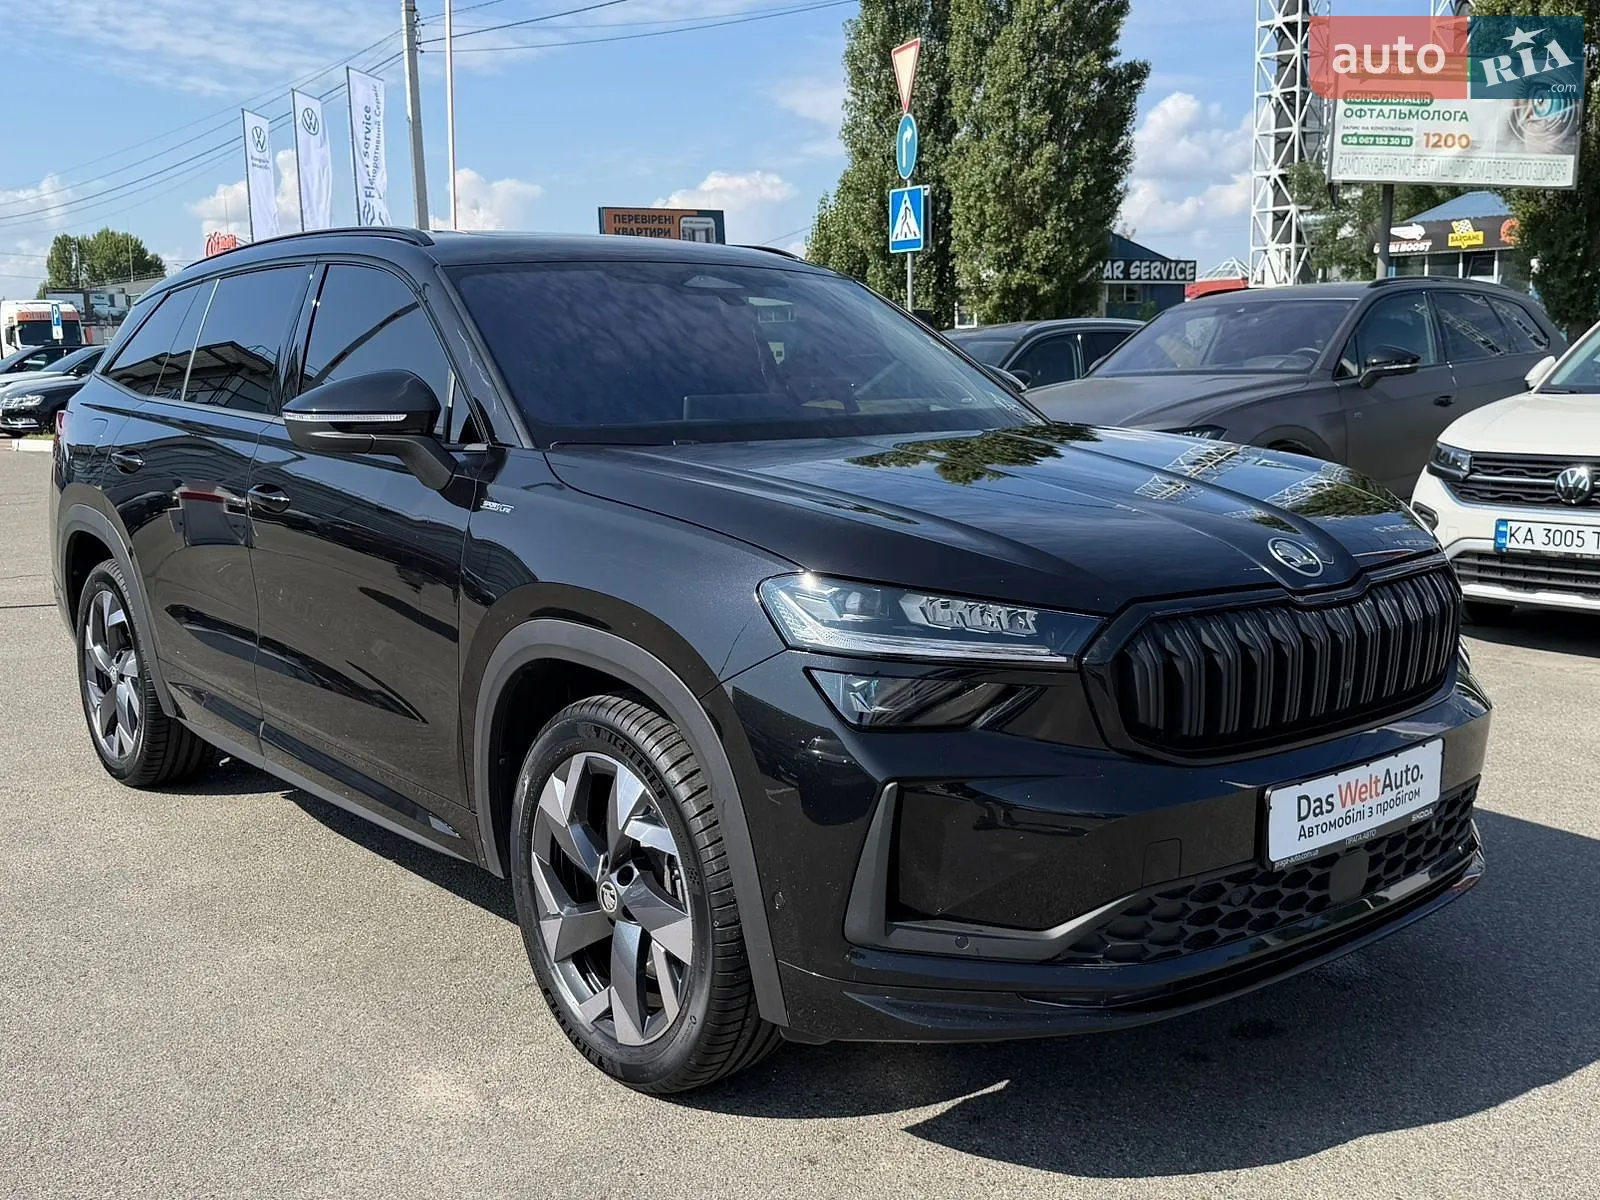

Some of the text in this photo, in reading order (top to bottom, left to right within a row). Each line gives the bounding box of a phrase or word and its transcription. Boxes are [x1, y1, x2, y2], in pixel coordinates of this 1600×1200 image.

[1343, 107, 1469, 122] ОФТАЛЬМОЛОГА
[1423, 132, 1472, 149] 1200
[613, 214, 675, 225] ПЕРЕВІРЕНІ
[614, 227, 672, 237] КВАРТИРИ
[1099, 260, 1195, 279] AR SERVICE
[1508, 526, 1535, 545] KA
[1541, 527, 1585, 548] 3005
[1297, 763, 1424, 822] Das WeltAuto.
[1298, 787, 1421, 841] Автомобілі з пробігом
